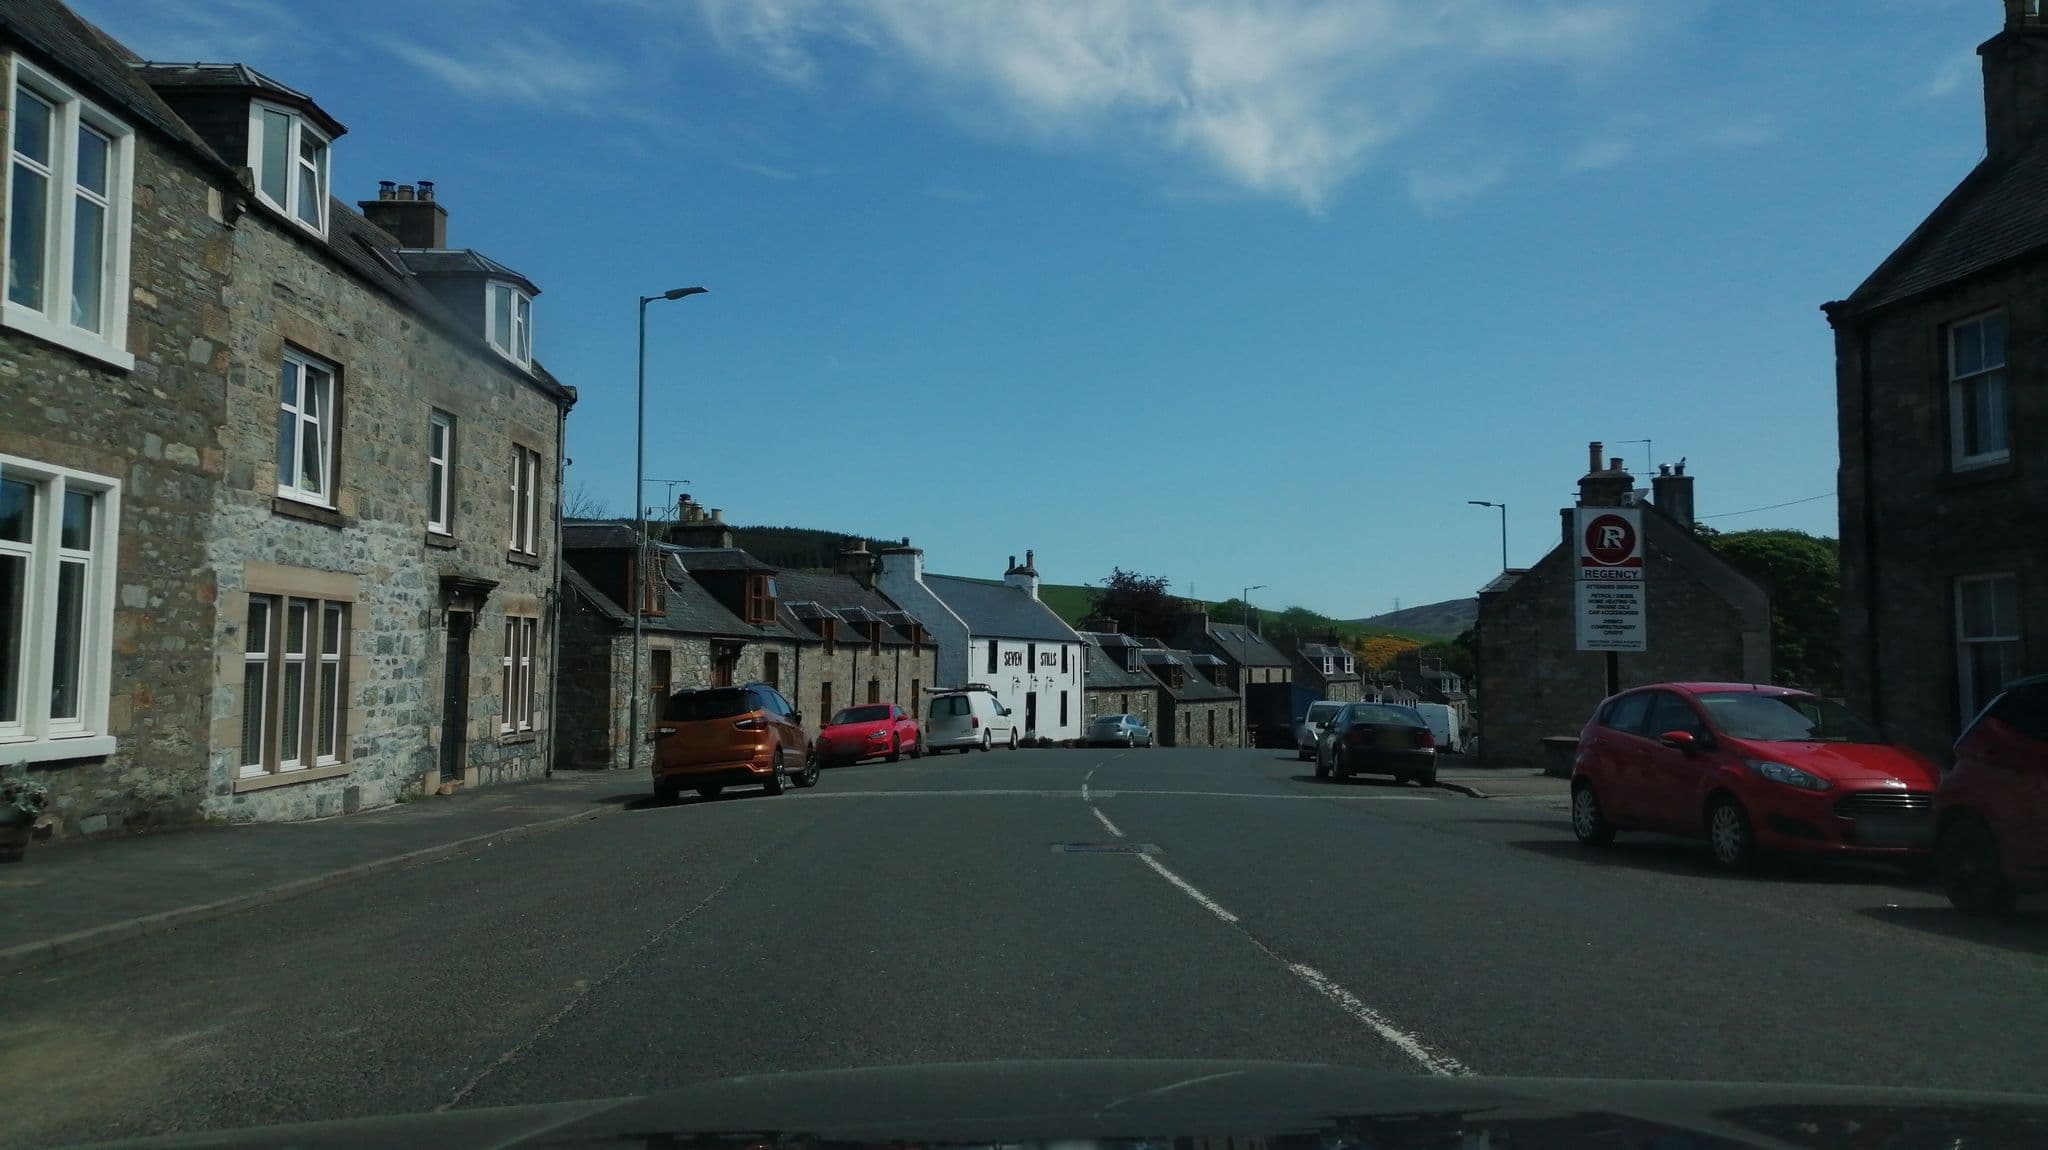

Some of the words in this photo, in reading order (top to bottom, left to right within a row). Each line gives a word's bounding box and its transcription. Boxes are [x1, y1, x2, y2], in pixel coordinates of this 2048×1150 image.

[1584, 569, 1639, 579] REGENCY
[1004, 651, 1023, 667] SEVEN
[1040, 652, 1057, 667] STILLS
